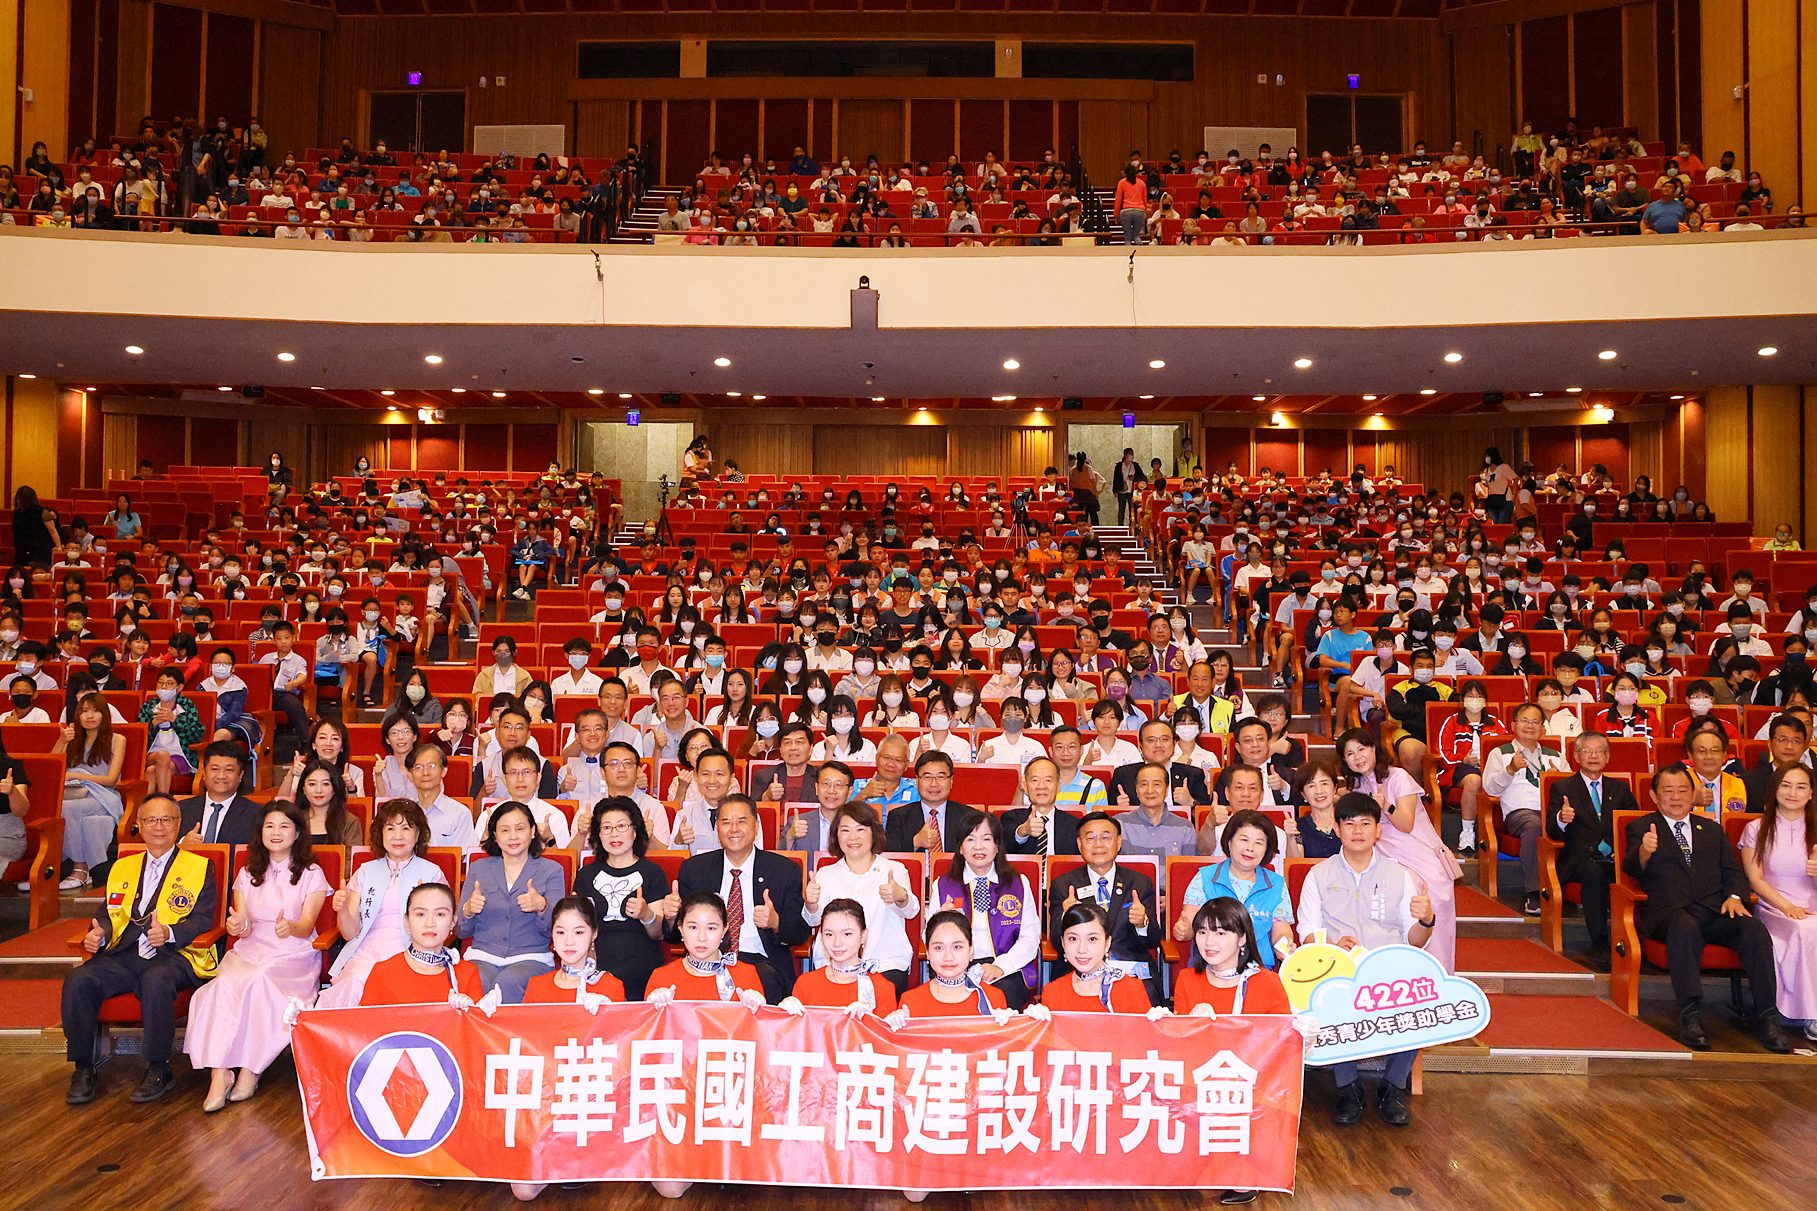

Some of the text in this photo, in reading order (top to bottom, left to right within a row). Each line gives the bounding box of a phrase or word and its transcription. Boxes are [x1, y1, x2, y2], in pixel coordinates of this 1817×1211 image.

[1355, 978, 1438, 1011] 422位
[1314, 1000, 1479, 1048] 秀青少年獎助學金
[484, 1037, 1259, 1157] 中華民國工商建設研究會
